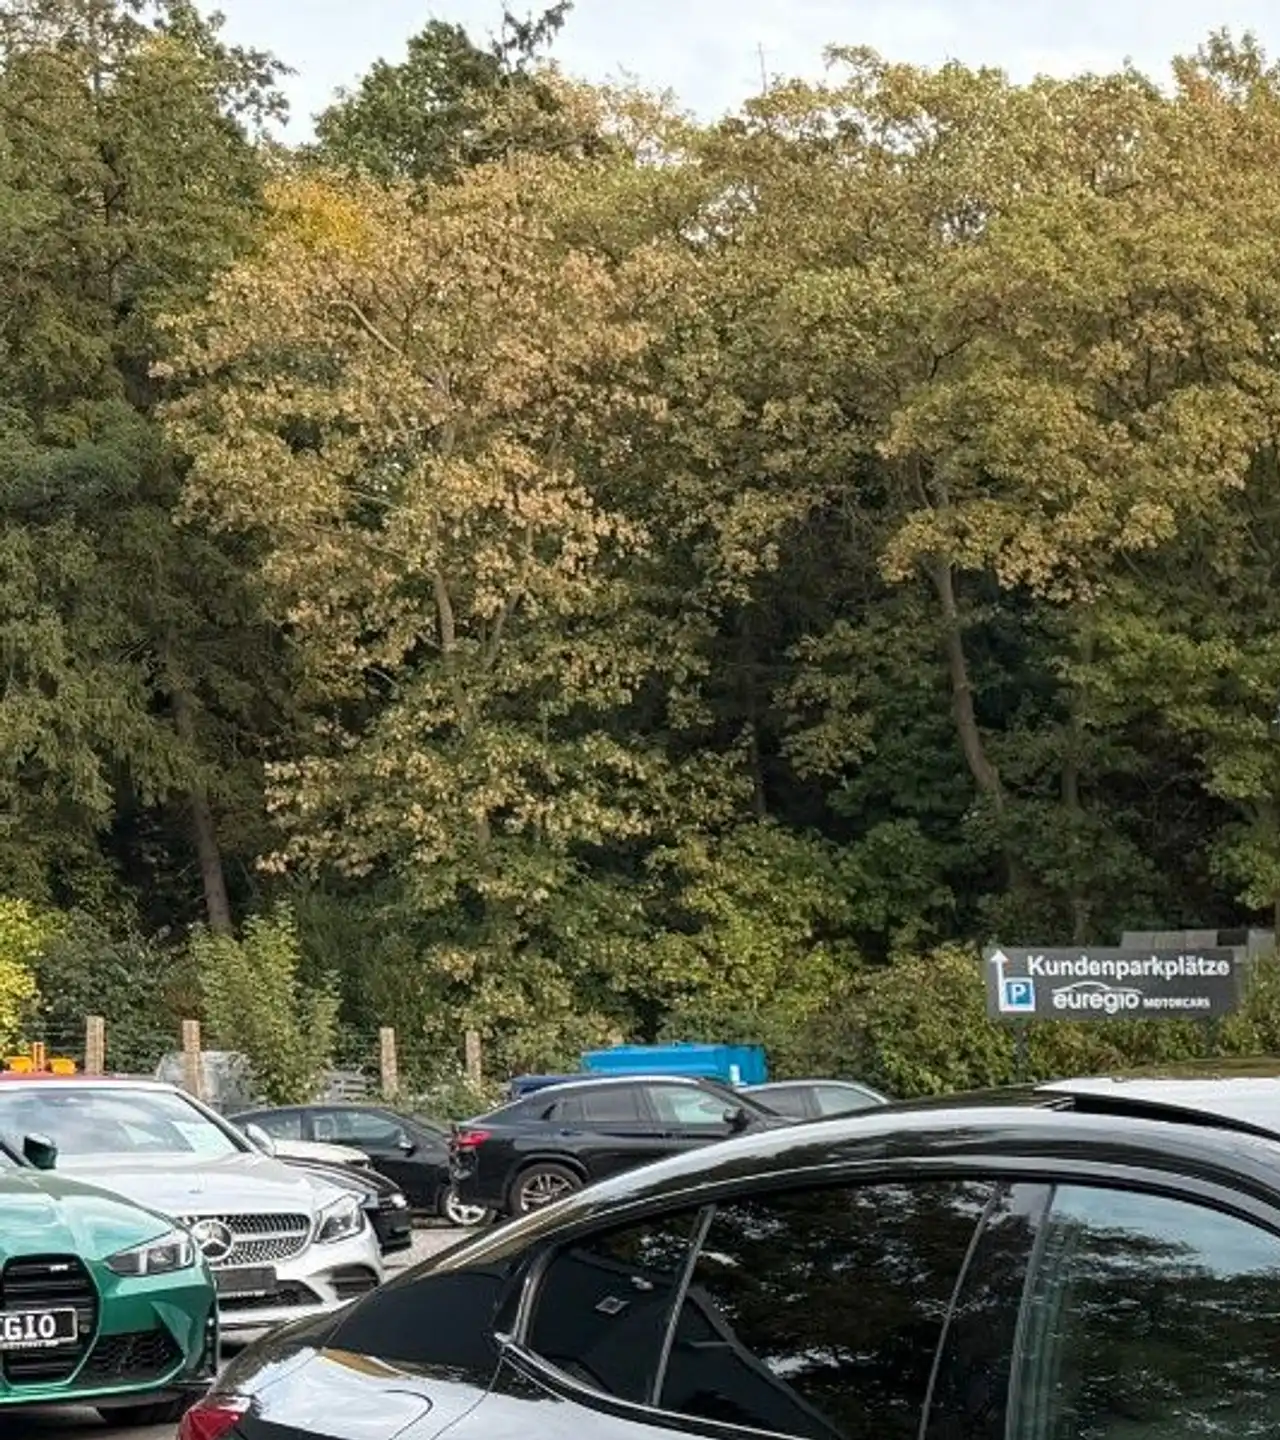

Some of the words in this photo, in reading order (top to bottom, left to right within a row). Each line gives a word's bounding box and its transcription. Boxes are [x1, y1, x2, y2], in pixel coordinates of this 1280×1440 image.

[1026, 954, 1231, 981] Kundenparkplätze
[1053, 991, 1140, 1014] euregio
[1143, 997, 1211, 1008] MOTORCARS
[0, 1314, 56, 1341] GIO
